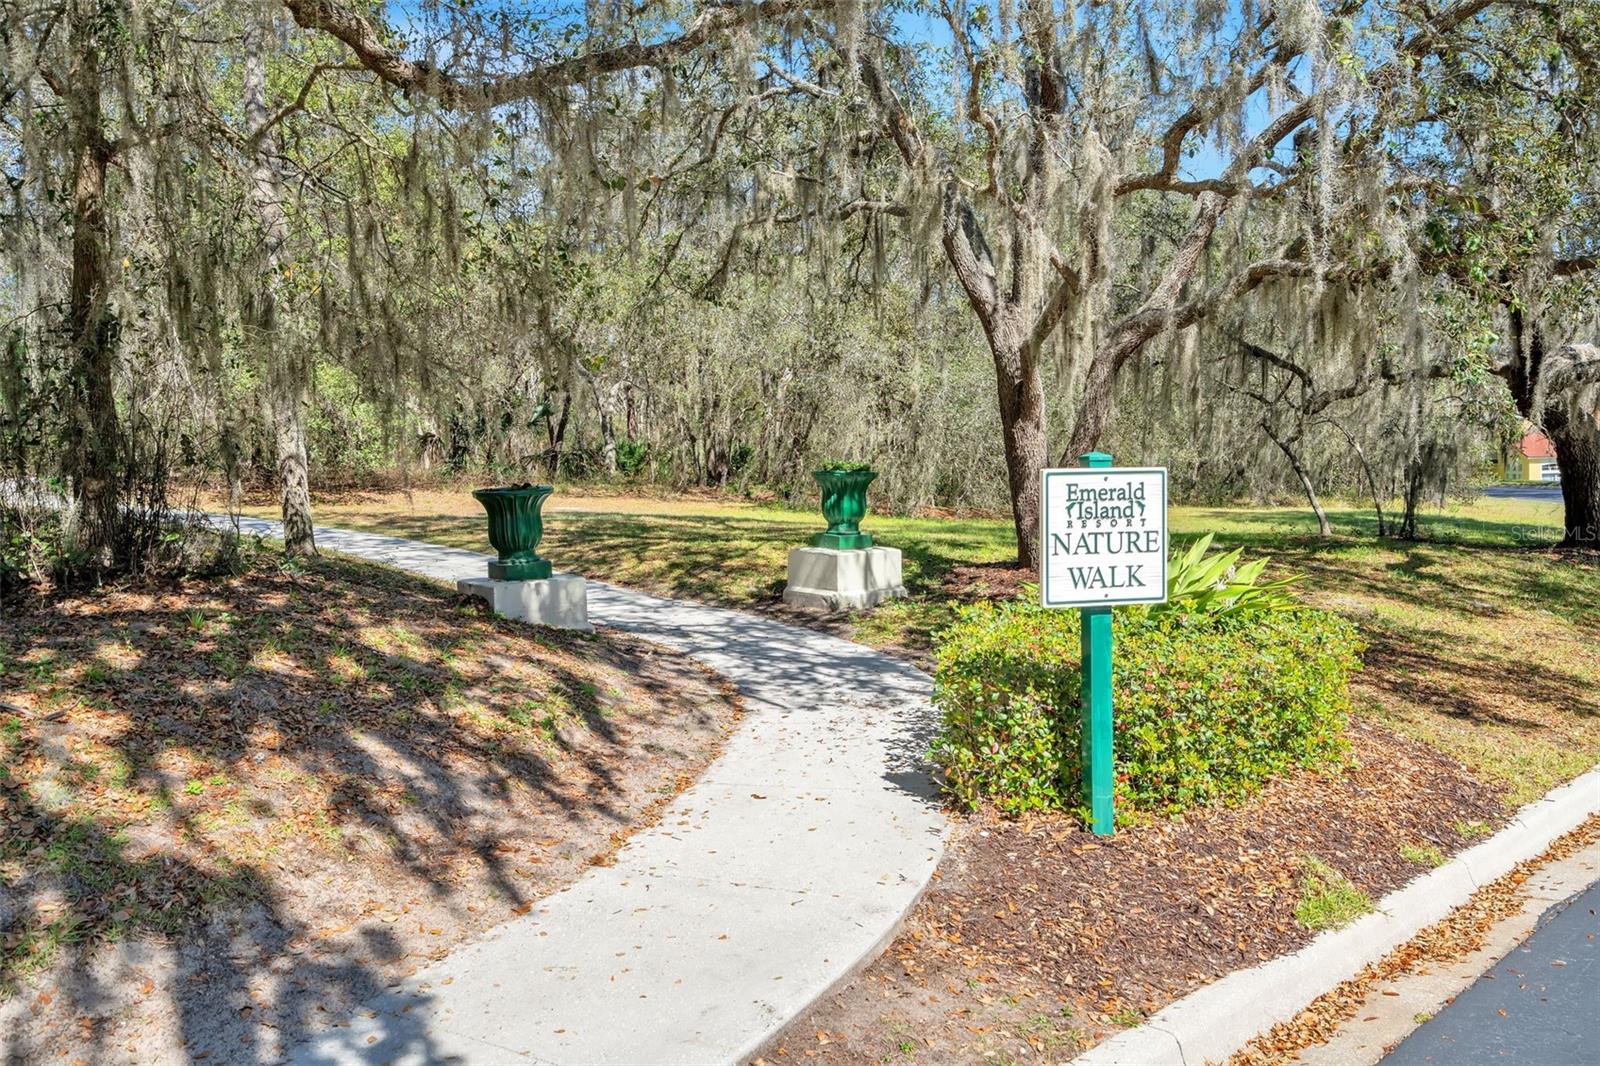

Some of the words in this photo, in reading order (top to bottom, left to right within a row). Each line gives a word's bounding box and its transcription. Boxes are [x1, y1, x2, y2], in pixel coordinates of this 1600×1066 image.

[1066, 482, 1145, 502] Emerald
[1076, 500, 1135, 520] Island
[1067, 518, 1147, 529] RESORT
[1051, 531, 1160, 556] NATURE
[1067, 565, 1146, 589] WALK
